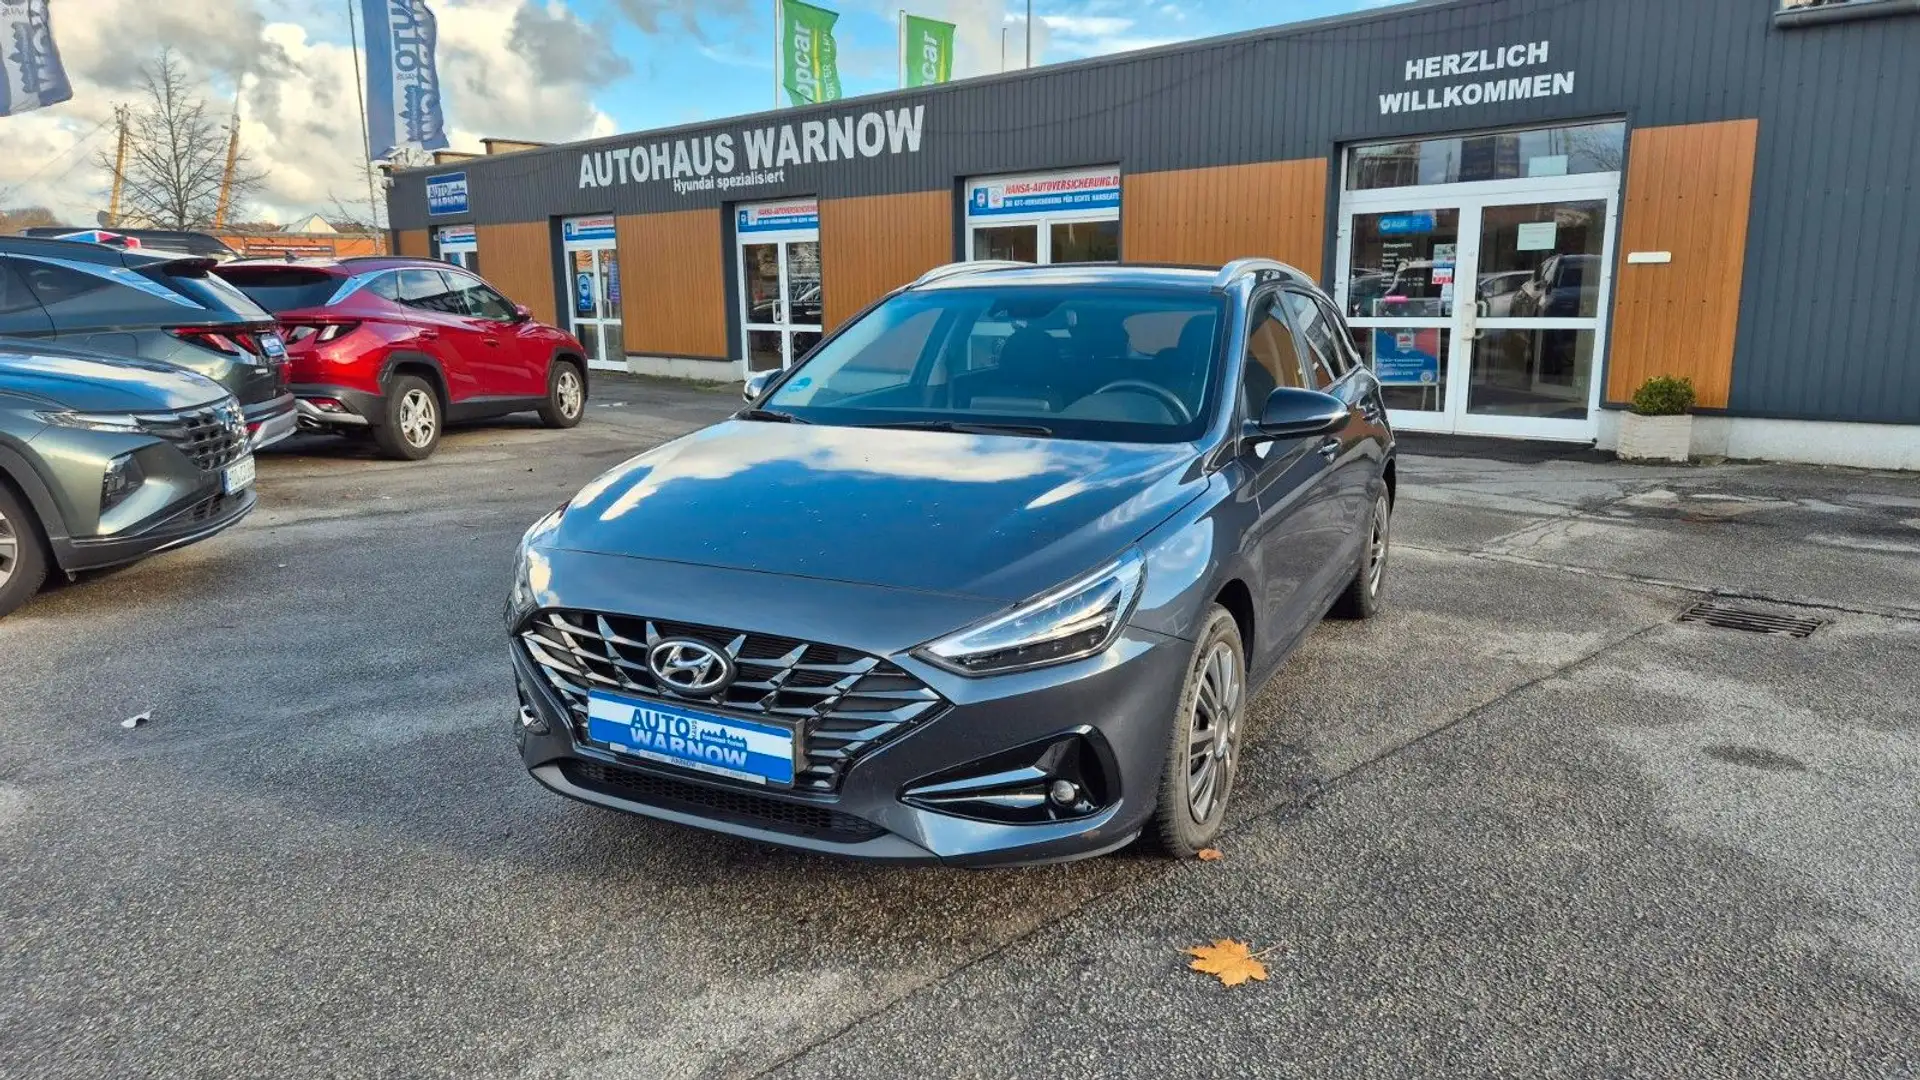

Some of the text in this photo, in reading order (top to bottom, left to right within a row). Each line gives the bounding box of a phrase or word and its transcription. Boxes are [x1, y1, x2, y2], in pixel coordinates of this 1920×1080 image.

[1405, 40, 1549, 81] HERZLICH
[1379, 71, 1575, 115] WILLKOMMEN
[579, 105, 925, 189] AUTOHAUS WARNOW
[673, 169, 784, 196] Hyundai spezialisiert
[1005, 175, 1120, 195] HANSA-AUTOVERSICHERUNG.D
[630, 709, 690, 740] AUTO
[630, 727, 748, 768] WARNOW
